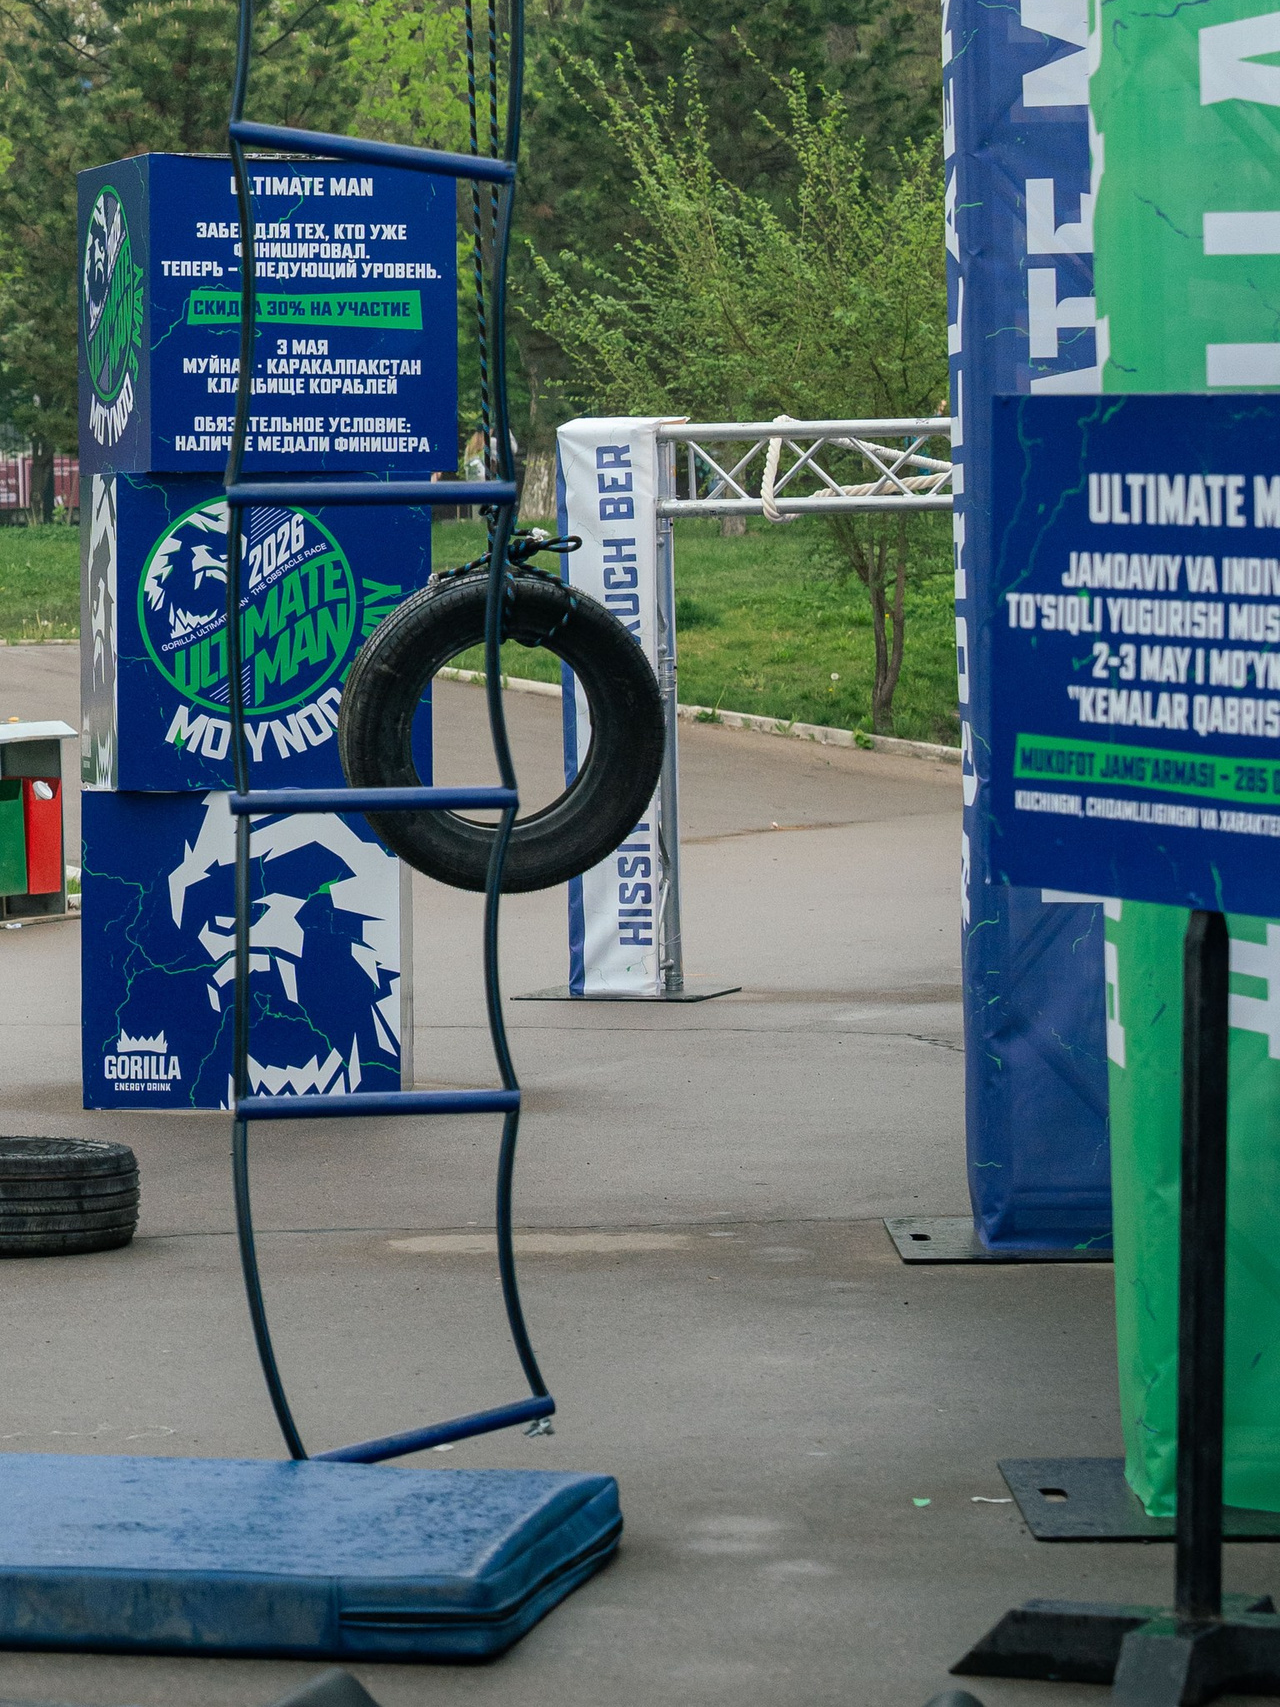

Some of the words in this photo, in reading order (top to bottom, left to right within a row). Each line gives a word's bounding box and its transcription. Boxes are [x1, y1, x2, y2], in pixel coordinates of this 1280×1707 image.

[230, 176, 324, 196] TIMATE
[330, 177, 374, 197] MAN
[196, 222, 243, 239] ЗАБЕ
[254, 222, 291, 240] ДЛЯ
[295, 223, 330, 241] ТЕХ,
[334, 224, 365, 240] КТО
[370, 224, 407, 240] УЖЕ
[234, 242, 370, 260] ФНИШИРОВАЛ.
[161, 260, 224, 277] ТЕПЕРЬ
[254, 259, 356, 279] ЛЕДУЮЩИЙ
[361, 262, 442, 279] УРОВЕНЬ.
[131, 263, 144, 349] MAY
[194, 300, 262, 317] СКИДА
[267, 300, 305, 317] 30%
[310, 300, 329, 316] НА
[337, 301, 410, 317] УЧАСТИЕ
[276, 339, 287, 355] 3
[292, 339, 329, 355] МАЯ
[183, 355, 241, 374] МУЙНА
[267, 358, 422, 375] КАРАКАЛПАКСТАН
[207, 377, 305, 396] КЛАБИЩЕ
[310, 376, 398, 394] КОРАБЛЕЙ
[328, 416, 411, 433] УСЛОВИЕ:
[175, 435, 252, 452] НАЛИЧЕ
[258, 436, 330, 454] МЕДАЛИ
[334, 436, 430, 453] ФИНИШЕРА
[596, 444, 635, 520] BER
[1088, 473, 1247, 528] ULTIMATE
[248, 513, 305, 589] 2026
[1061, 551, 1183, 592] JAMOAVIY
[1184, 555, 1219, 593] VA
[1221, 557, 1280, 596] INDIV
[161, 634, 196, 652] GORILLA
[196, 613, 228, 638] ULTIMAT
[250, 584, 267, 596] THE
[266, 554, 304, 584] OBSTACLE
[304, 542, 327, 557] RACE
[1005, 592, 1103, 636] TO'SIQLI
[1106, 597, 1225, 640] YUGURISH
[255, 603, 347, 707] MAN
[1092, 642, 1137, 681] 2-3
[1140, 644, 1192, 684] MAY
[1209, 648, 1280, 690] MO'YN
[1192, 694, 1280, 738] QABRIS
[1021, 747, 1095, 777] MUKOFOT
[1234, 765, 1268, 793] 285
[1200, 807, 1219, 830] VA
[104, 1055, 182, 1080] GORILLA
[114, 1082, 146, 1092] ENERGY
[147, 1082, 172, 1092] DRINK
